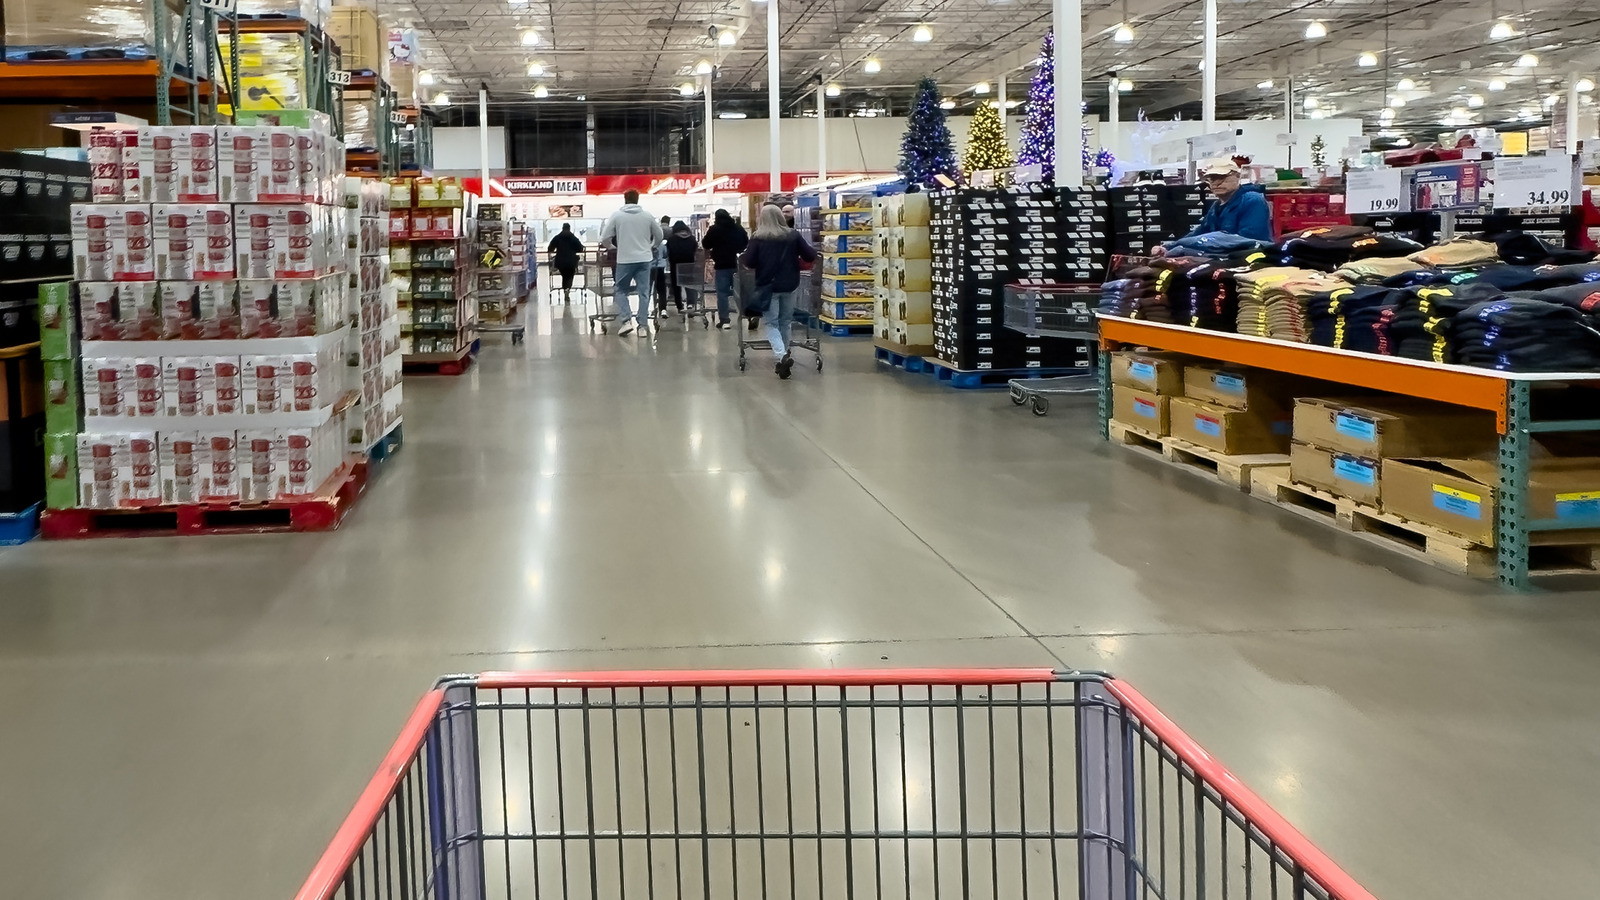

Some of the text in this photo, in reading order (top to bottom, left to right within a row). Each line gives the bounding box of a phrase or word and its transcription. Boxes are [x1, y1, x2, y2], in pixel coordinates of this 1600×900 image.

[330, 71, 350, 83] 313
[507, 181, 583, 192] KIRKLAND MEAT
[717, 178, 740, 190] BEEF
[1527, 189, 1569, 205] 34.99
[1370, 197, 1398, 211] 19.99
